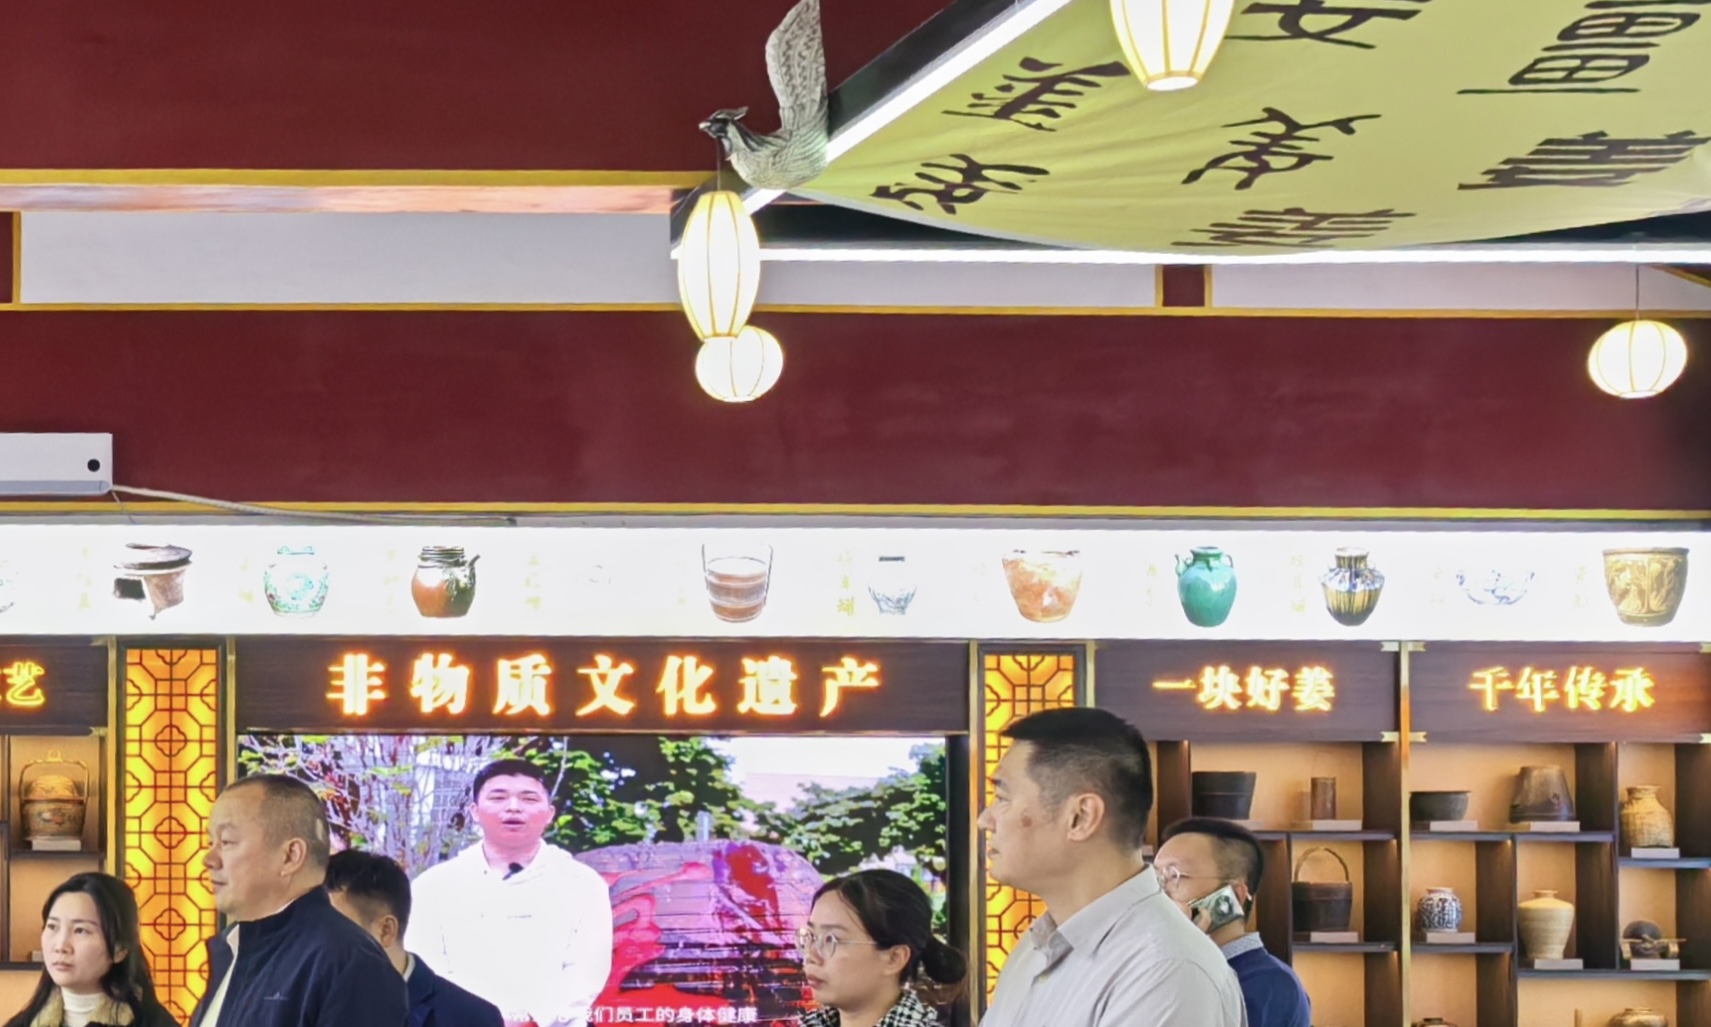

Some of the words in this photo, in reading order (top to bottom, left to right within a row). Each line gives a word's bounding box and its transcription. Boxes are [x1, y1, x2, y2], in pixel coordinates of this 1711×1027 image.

[327, 653, 881, 718] 非物质文化遗产
[1151, 664, 1336, 712] 一块好姜
[1467, 665, 1656, 713] 千年传承
